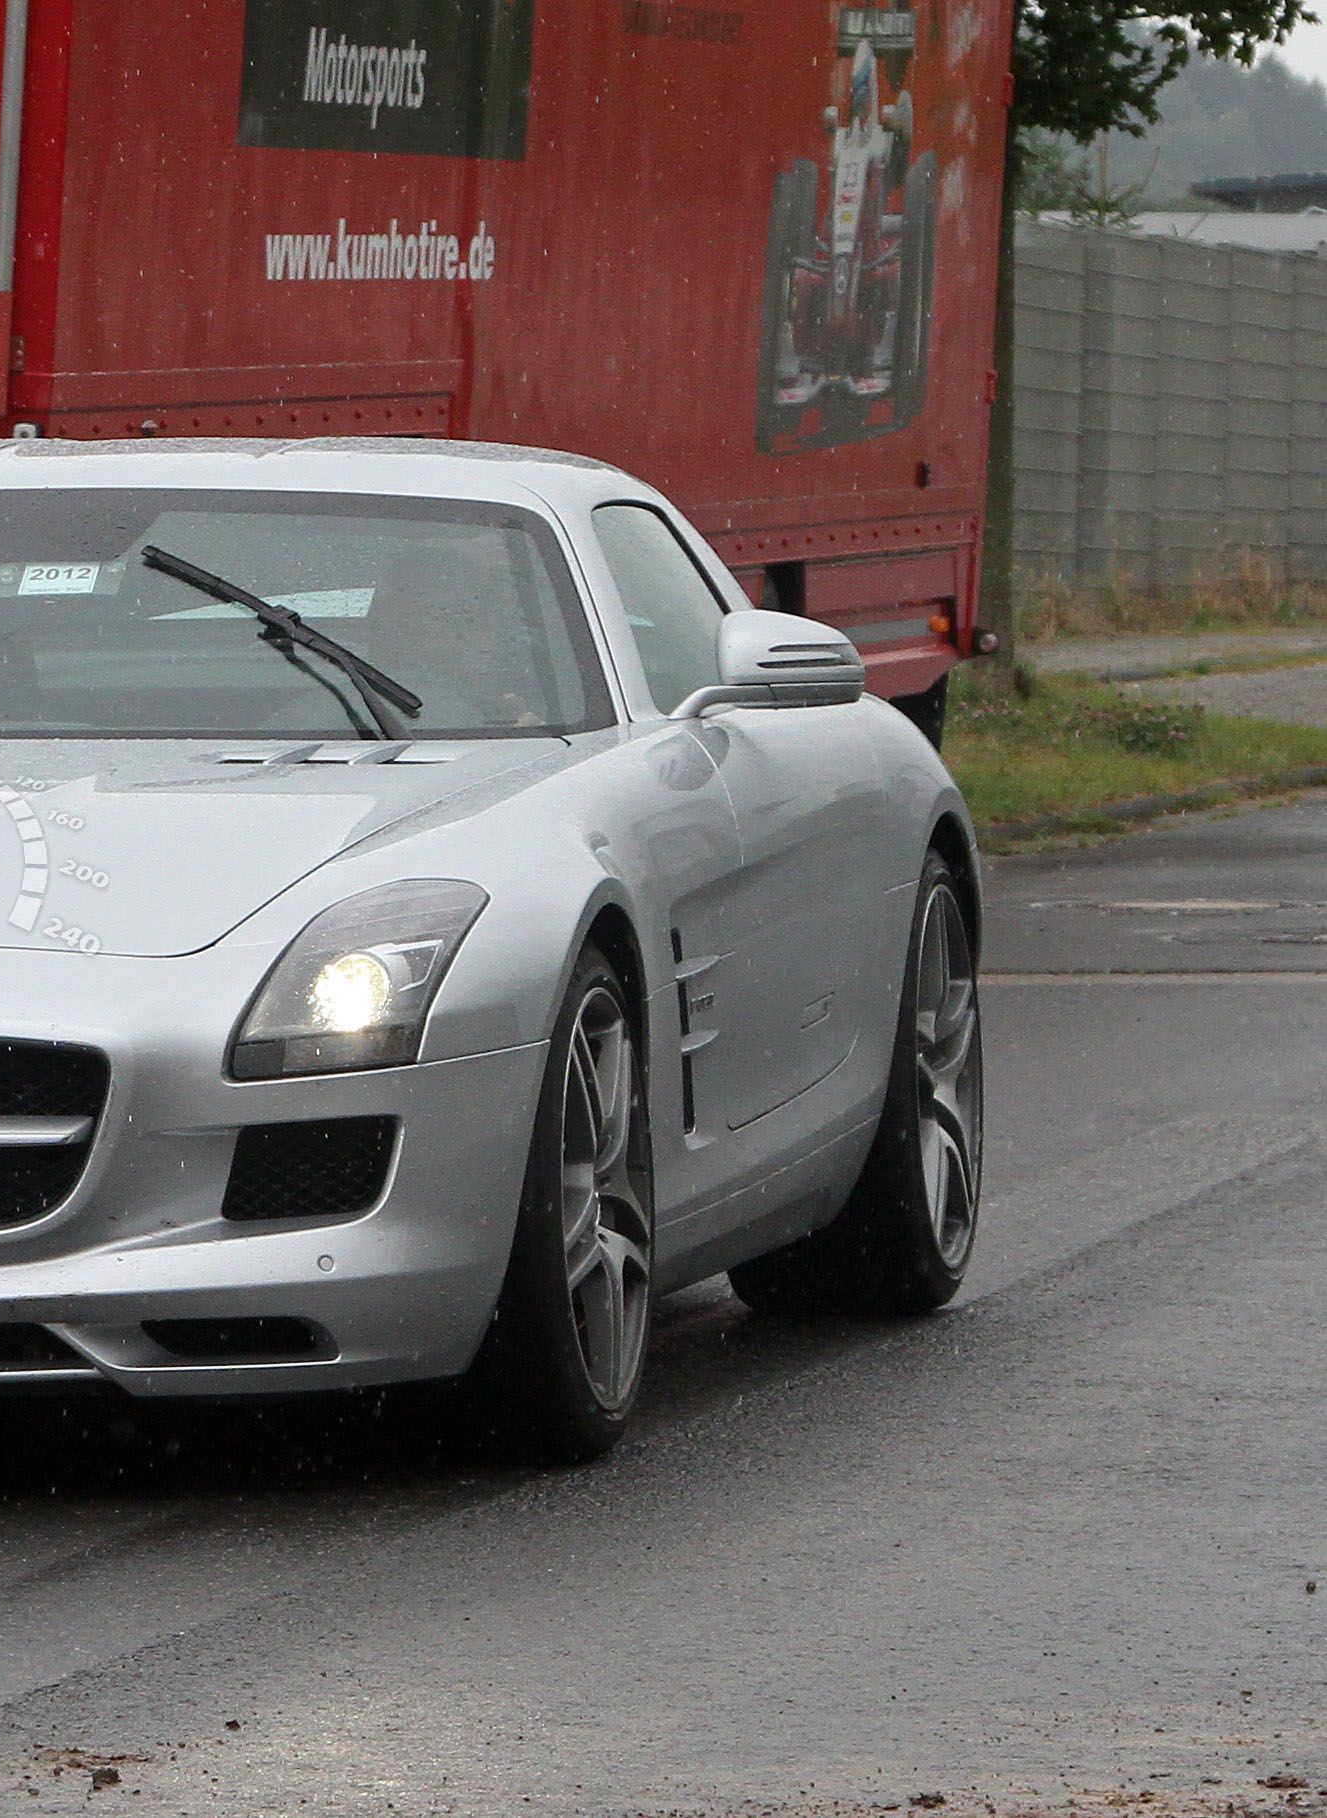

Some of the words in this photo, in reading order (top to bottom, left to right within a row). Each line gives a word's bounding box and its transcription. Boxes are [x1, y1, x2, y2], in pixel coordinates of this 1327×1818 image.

[303, 26, 427, 129] Motorsports
[265, 217, 496, 280] www.kumhotire.de
[29, 567, 92, 581] 2012
